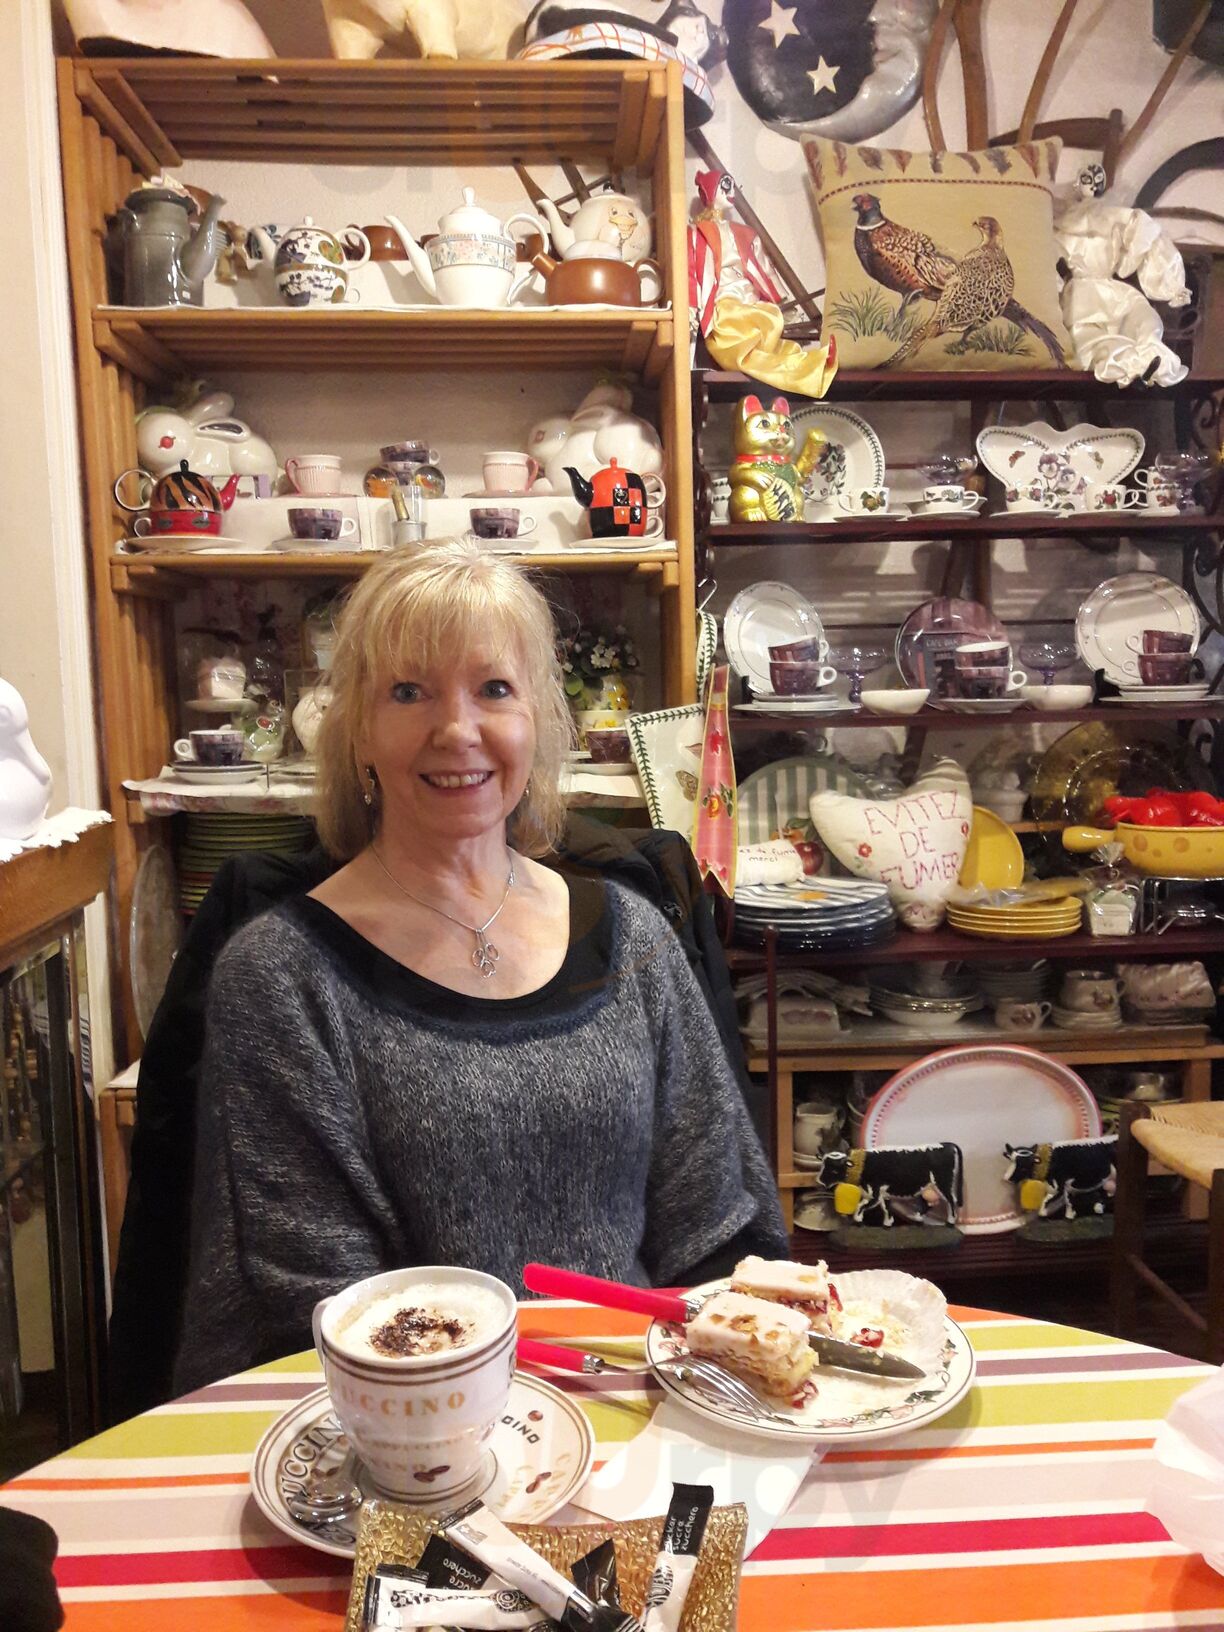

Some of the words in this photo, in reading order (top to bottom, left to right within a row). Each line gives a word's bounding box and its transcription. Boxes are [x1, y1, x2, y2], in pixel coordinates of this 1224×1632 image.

[863, 788, 965, 835] EVITEZ
[900, 827, 936, 859] DE
[880, 852, 960, 890] FUMER
[681, 1505, 700, 1551] zucchero
[448, 1575, 474, 1591] ucre
